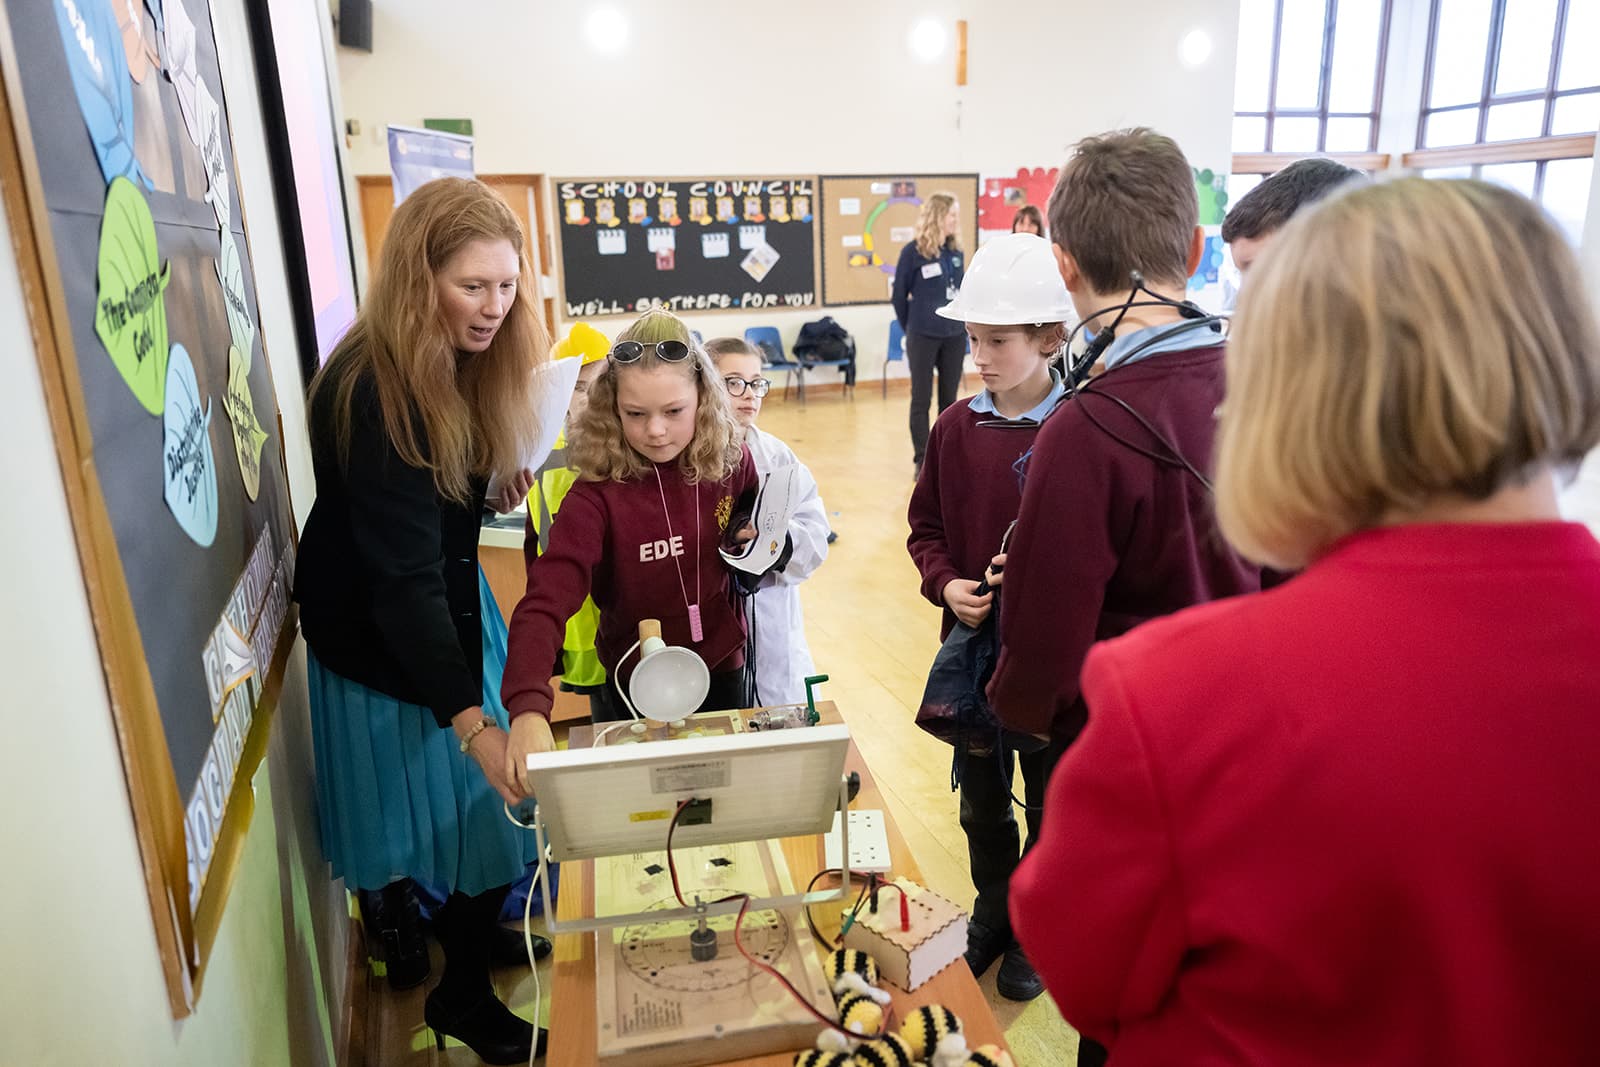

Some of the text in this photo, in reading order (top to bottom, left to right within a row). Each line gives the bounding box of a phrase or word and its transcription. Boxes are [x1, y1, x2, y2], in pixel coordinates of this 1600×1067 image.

[561, 181, 812, 199] SCHOOL COUNCIL
[567, 292, 813, 317] WE'LL BE THERE FOR YOU
[639, 535, 685, 562] EDE
